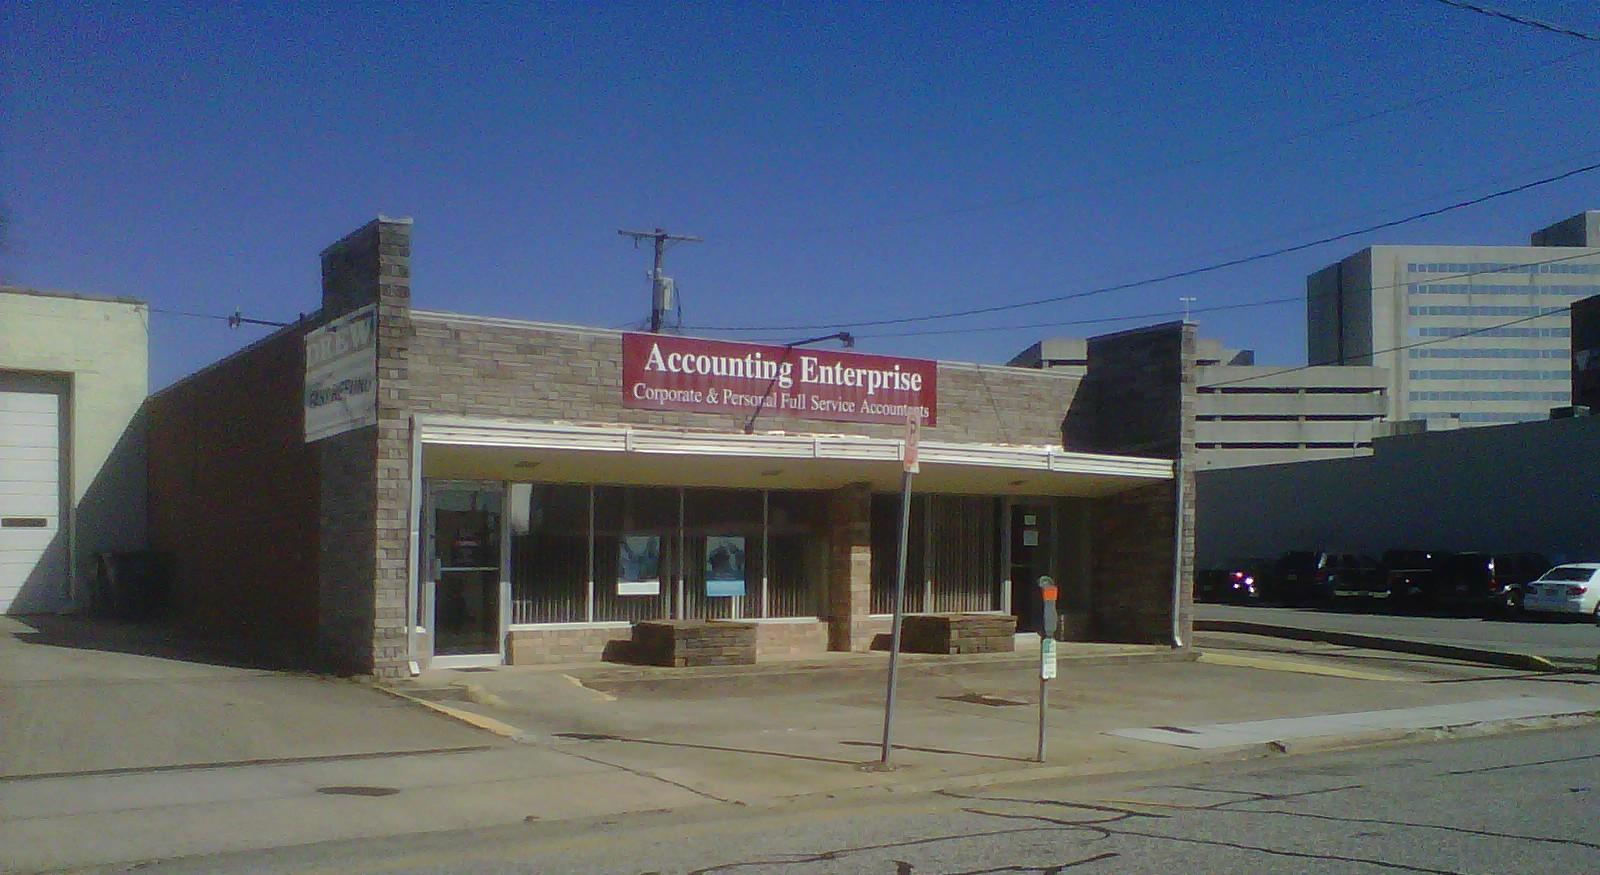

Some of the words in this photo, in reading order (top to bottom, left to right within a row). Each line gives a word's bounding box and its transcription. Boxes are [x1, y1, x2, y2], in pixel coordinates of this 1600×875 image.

[644, 343, 793, 389] Accounting
[800, 356, 922, 395] Enterprise
[633, 382, 702, 405] Corporate
[706, 388, 719, 404] &
[723, 388, 777, 408] Personal
[781, 392, 806, 410] Full
[811, 395, 856, 412] Service
[860, 399, 930, 418] Accountts
